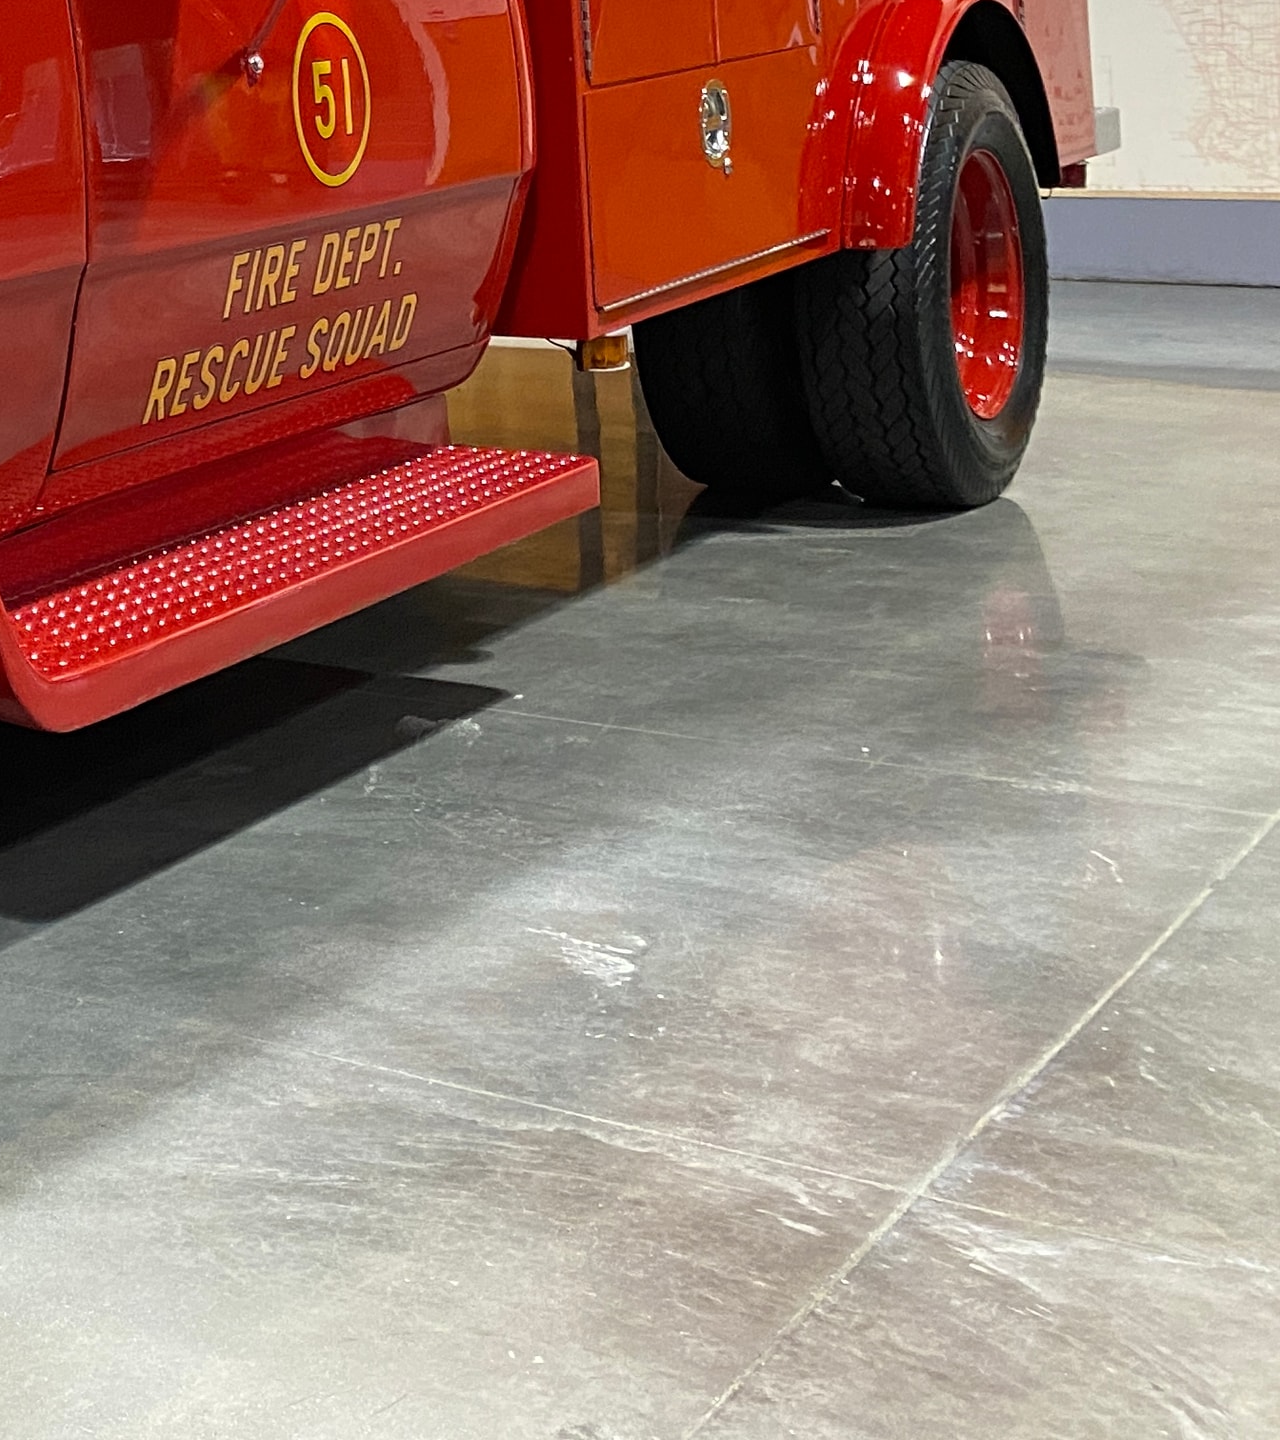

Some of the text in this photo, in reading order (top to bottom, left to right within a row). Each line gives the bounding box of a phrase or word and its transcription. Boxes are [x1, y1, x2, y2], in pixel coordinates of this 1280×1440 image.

[311, 58, 354, 139] 51
[222, 216, 402, 321] FIRE DEPT.
[141, 292, 418, 426] RESCUE SQUAD
